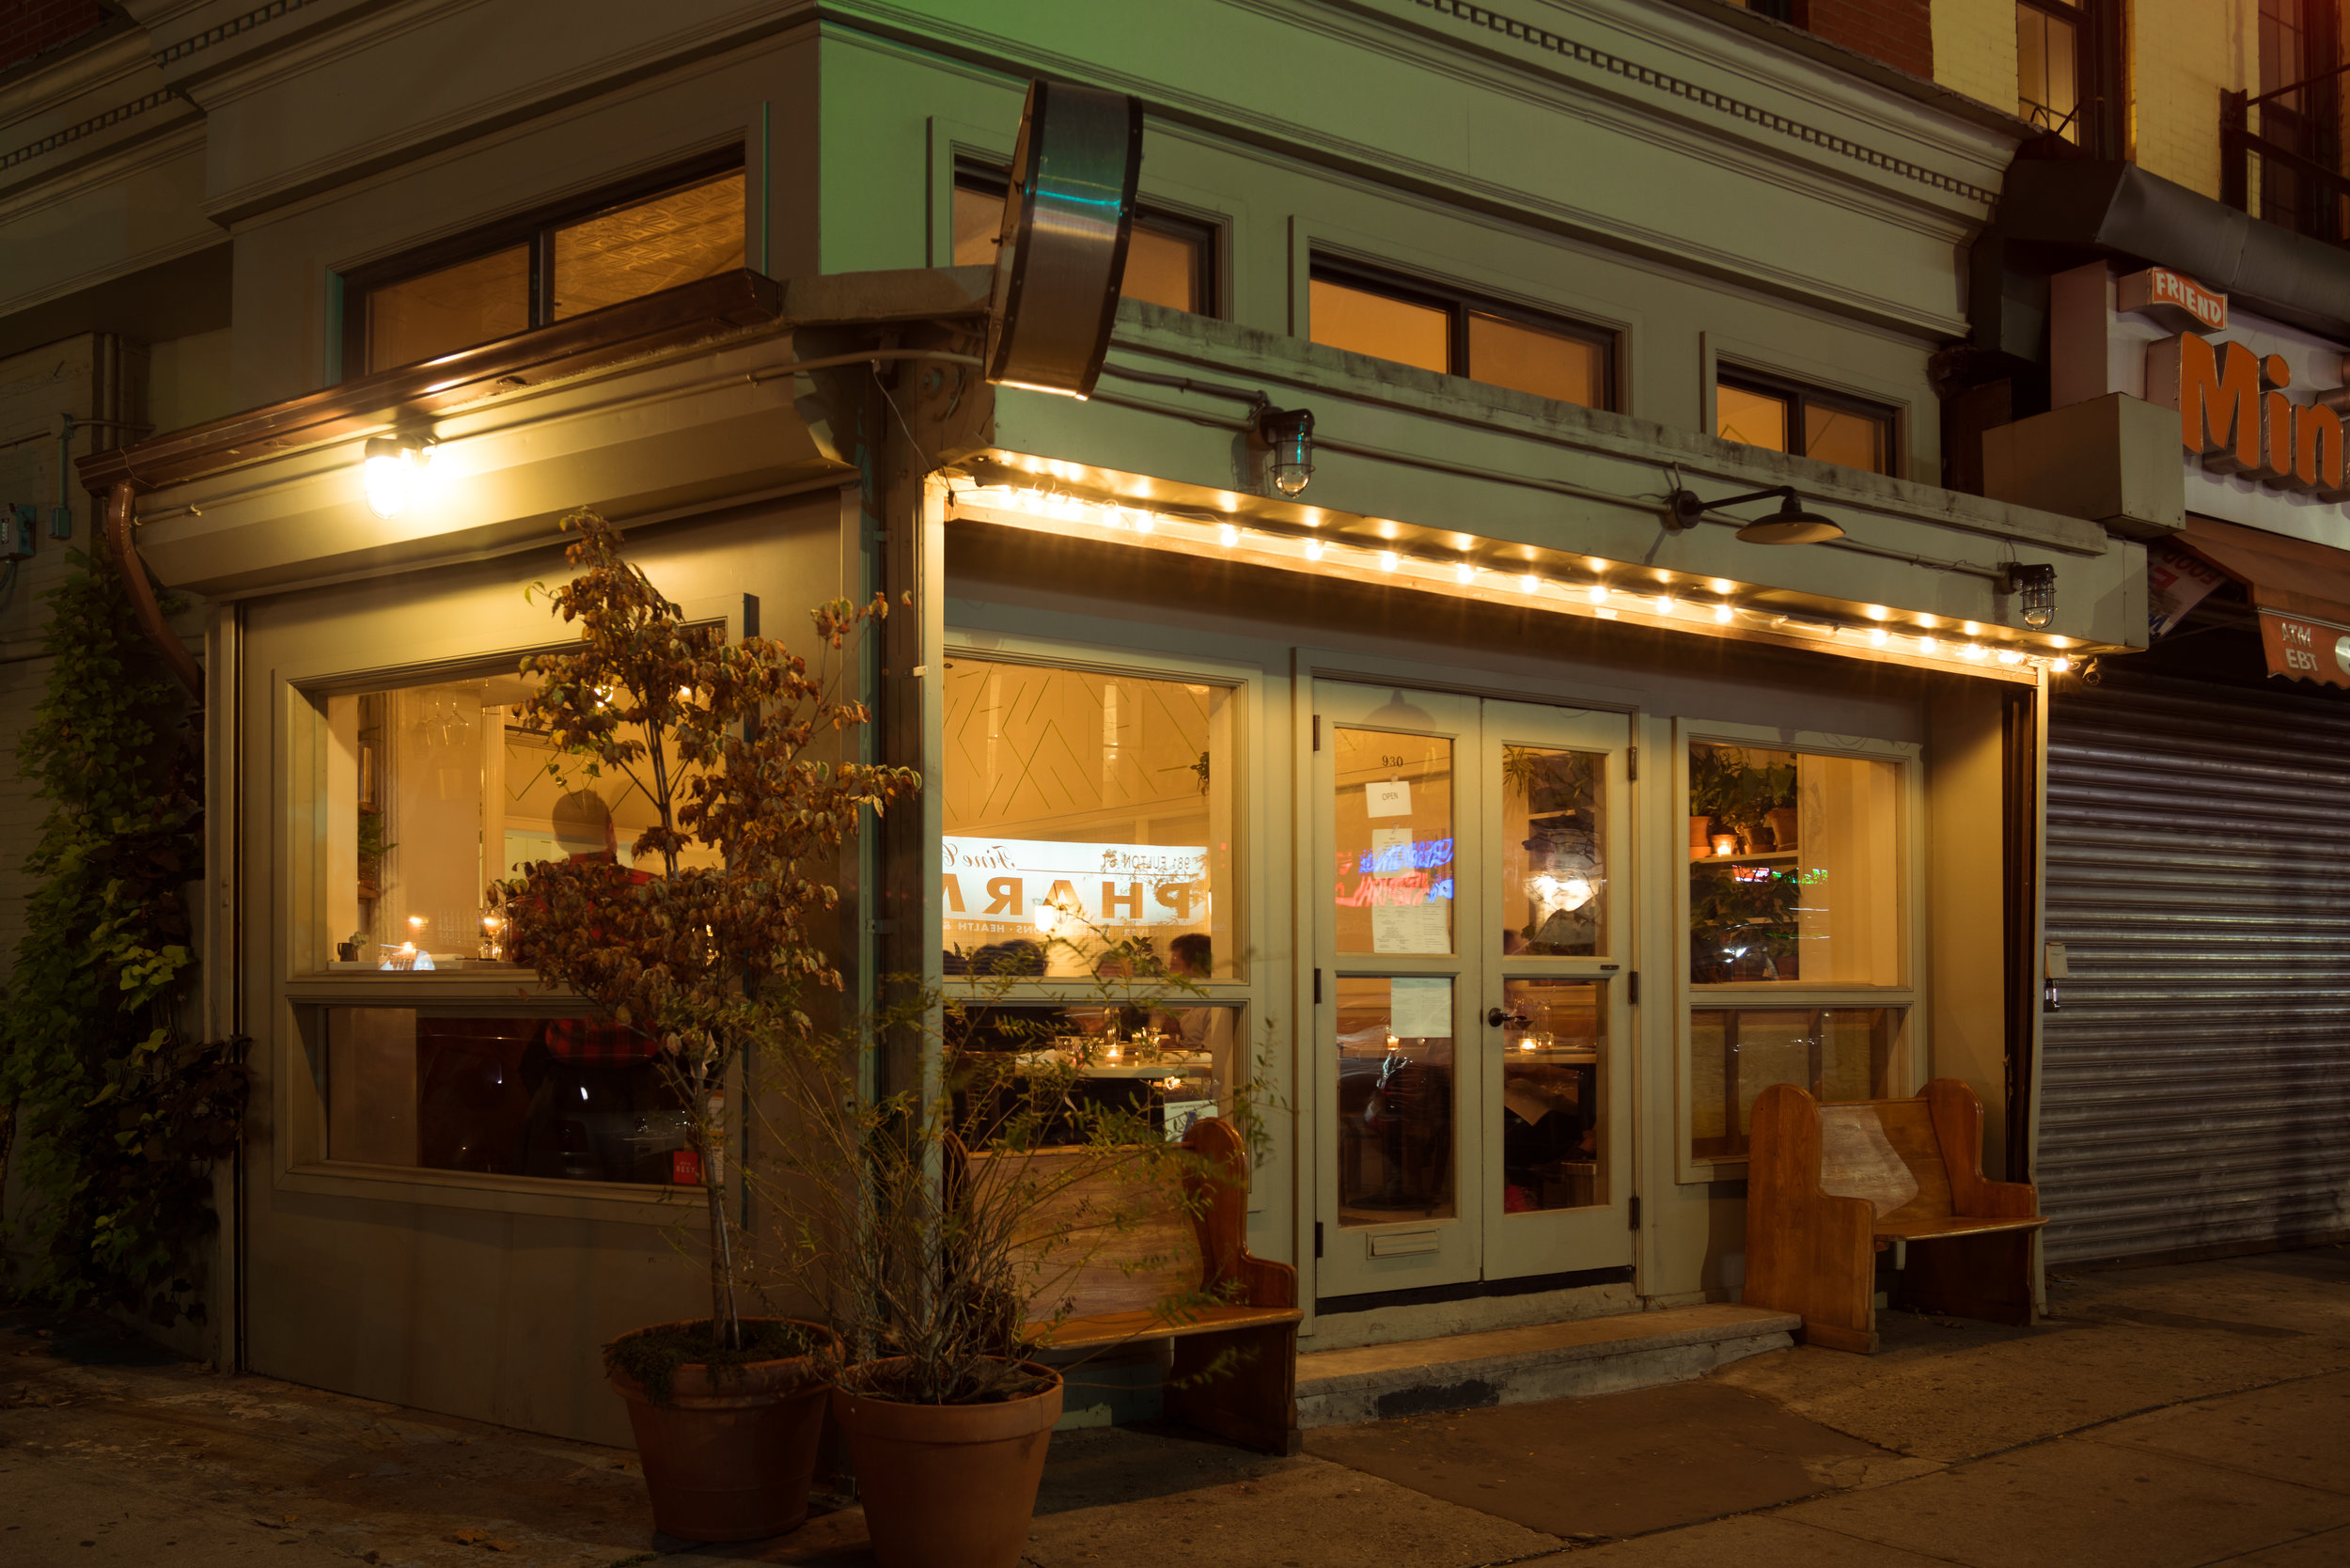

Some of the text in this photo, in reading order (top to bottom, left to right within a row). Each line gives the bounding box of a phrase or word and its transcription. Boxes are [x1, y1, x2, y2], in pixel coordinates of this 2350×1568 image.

[2155, 272, 2222, 324] FRIEND
[2180, 330, 2343, 490] Min
[2281, 621, 2312, 648] ATM
[2285, 648, 2318, 672] EBT
[1382, 755, 1403, 768] 930
[1382, 792, 1399, 801] OPEN
